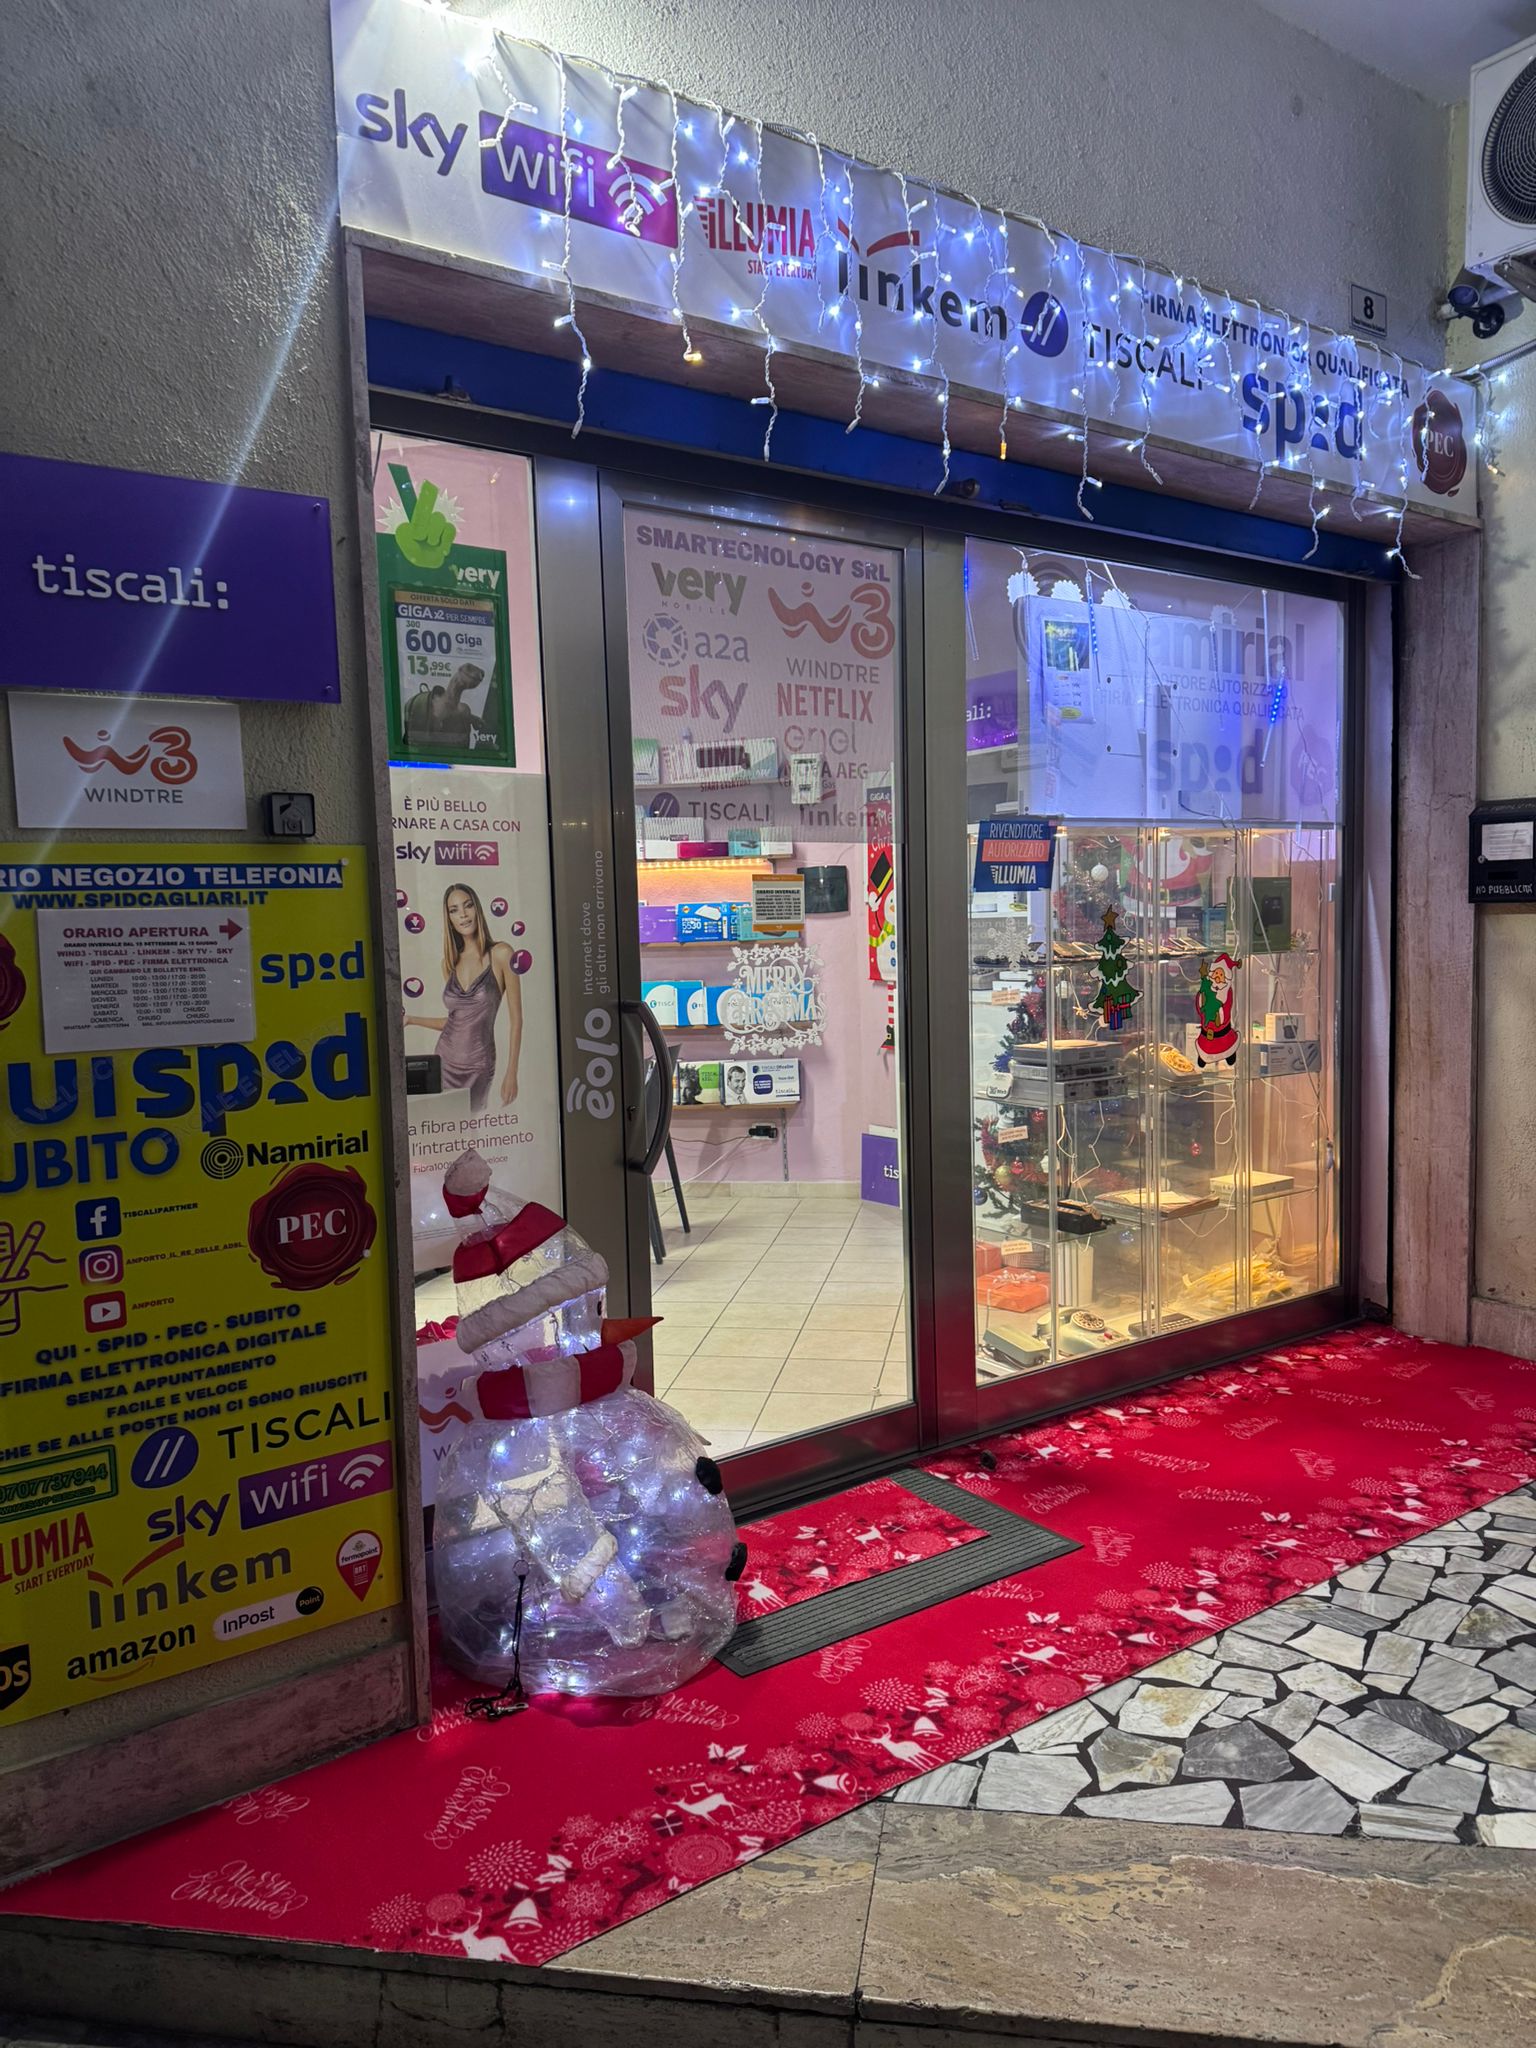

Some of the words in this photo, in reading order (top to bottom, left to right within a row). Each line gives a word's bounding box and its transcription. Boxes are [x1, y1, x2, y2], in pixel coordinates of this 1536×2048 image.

[355, 88, 468, 176] sky
[500, 140, 596, 208] wifi
[838, 250, 1008, 342] linkem
[1363, 296, 1374, 320] 8
[1081, 320, 1203, 391] TISCALI
[1426, 428, 1455, 458] PEC
[636, 524, 845, 575] SMARTECNOLOGY
[851, 560, 891, 582] SRL
[32, 553, 229, 610] tiscali:
[651, 561, 748, 616] very
[398, 604, 433, 619] GIGA
[446, 613, 460, 621] PER
[460, 614, 487, 624] SEMPRE
[410, 594, 440, 603] OFFERTA
[440, 596, 459, 605] SOLO
[662, 601, 726, 616] MOBILE
[405, 629, 452, 654] 600
[455, 633, 482, 647] Giga
[695, 630, 750, 663] a2a
[786, 656, 880, 685] WINDTRE
[659, 664, 748, 734] sky
[776, 682, 874, 724] NETFLIX
[783, 720, 857, 756] enel
[836, 762, 868, 779] AEG
[84, 786, 184, 804] WINDTRE
[404, 796, 413, 811] È
[416, 797, 440, 812] PIÙ
[444, 800, 487, 813] BELLO
[440, 820, 450, 831] A
[453, 820, 489, 832] CASA
[492, 820, 521, 832] CON
[688, 801, 770, 822] TISCALI
[989, 822, 1045, 840] RIVENDITORE
[396, 841, 431, 864] sky
[438, 843, 473, 861] wifi
[987, 841, 1046, 859] AUTORIZZATO
[52, 866, 186, 887] NEGOZIO
[194, 866, 343, 886] TELEFONIA
[593, 849, 605, 910] arrivano
[1475, 885, 1487, 894] NO
[13, 891, 268, 909] WWW.SPIDCAGLIARI.IT
[63, 927, 124, 939] ORARIO
[128, 926, 209, 939] APERTURA
[580, 900, 591, 937] dove
[596, 913, 605, 941] non
[682, 921, 702, 930] 5530
[57, 949, 86, 957] WIND3
[137, 948, 170, 956] LINKEM
[90, 959, 111, 967] SPID
[171, 957, 228, 965] ELETTRONICA
[582, 939, 593, 996] Internet
[595, 943, 606, 974] altri
[596, 977, 611, 995] gli
[739, 964, 810, 996] MERRY
[576, 1007, 619, 1120] eolo
[421, 1120, 456, 1135] fibra
[459, 1113, 519, 1134] perfetta
[246, 1130, 369, 1168] Namirial
[412, 1131, 534, 1157] l'intrattenimento
[122, 1202, 199, 1218] TISCALIPARTNER
[276, 1208, 348, 1245] PEC
[131, 1297, 175, 1310] ANPORTO
[36, 1344, 77, 1365] QUI
[97, 1333, 148, 1354] SPID
[167, 1320, 208, 1341] PEC
[226, 1303, 301, 1329] SUBITO
[0, 1371, 73, 1397] FIRMA
[80, 1343, 230, 1382] ELETTRONICA
[236, 1322, 327, 1352] DIGITALE
[66, 1384, 129, 1407] SENZA
[133, 1354, 277, 1394] APPUNTAMENTO
[37, 1439, 62, 1454] SE
[67, 1427, 114, 1448] ALLE
[119, 1412, 179, 1436] POSTE
[183, 1403, 221, 1423] NON
[226, 1398, 244, 1413] CI
[248, 1387, 296, 1407] SONO
[299, 1371, 368, 1397] RIUSCITI
[106, 1396, 166, 1419] FACILE
[170, 1393, 182, 1405] E
[186, 1379, 248, 1402] VELOCE
[217, 1390, 392, 1460] TISCALI
[148, 1494, 231, 1542] sky
[249, 1463, 329, 1515] wifi
[341, 1546, 378, 1563] fermopoint
[14, 1573, 44, 1595] START
[47, 1553, 95, 1583] EVERYDAY
[88, 1546, 292, 1630] linkem
[223, 1606, 275, 1634] InPost
[299, 1594, 321, 1607] Point
[66, 1623, 197, 1681] amazon
